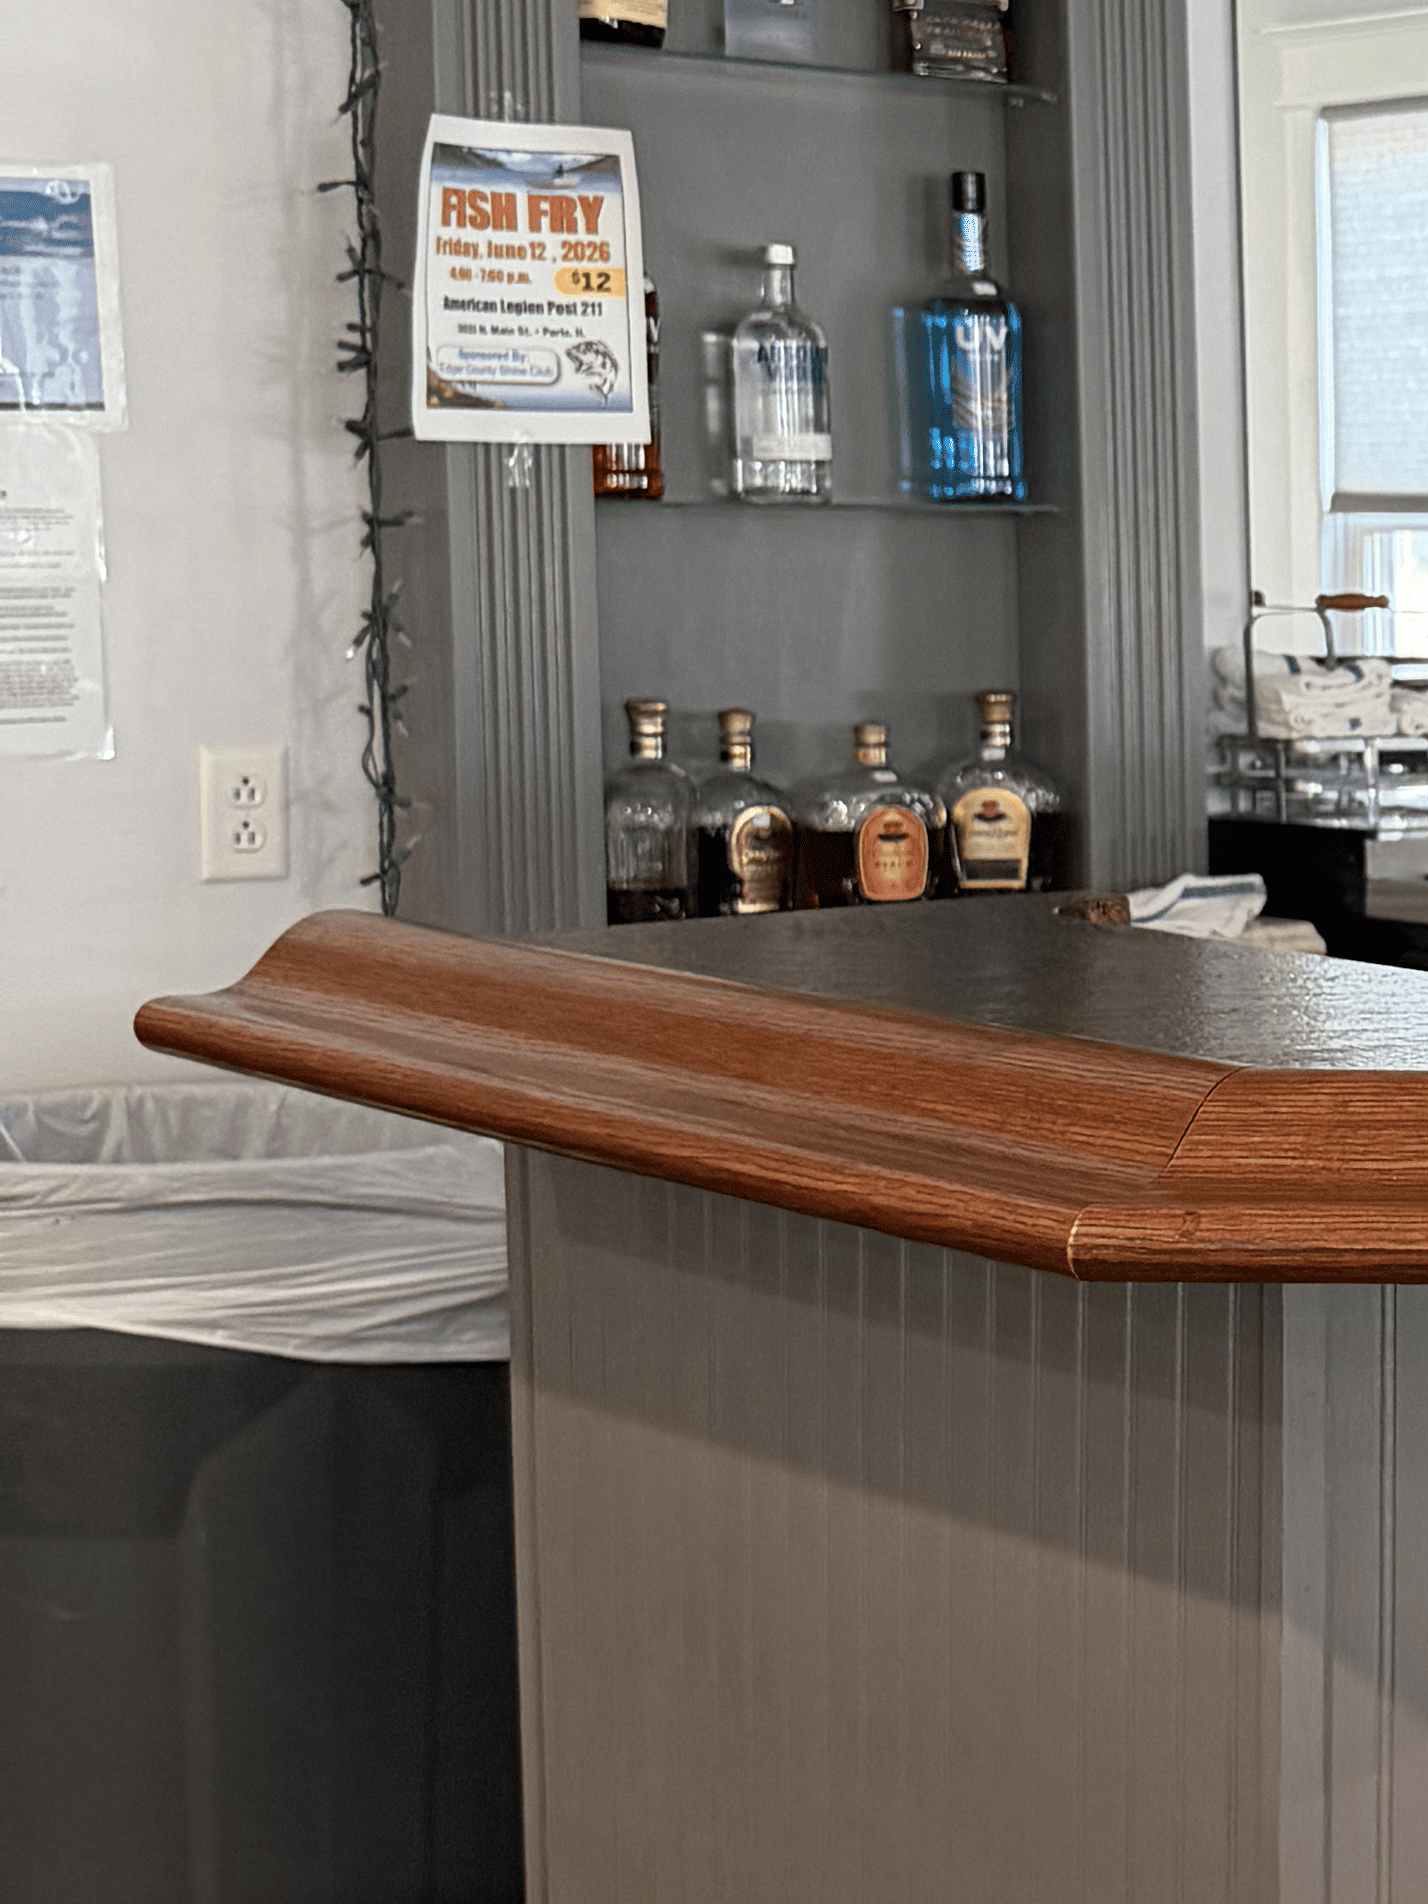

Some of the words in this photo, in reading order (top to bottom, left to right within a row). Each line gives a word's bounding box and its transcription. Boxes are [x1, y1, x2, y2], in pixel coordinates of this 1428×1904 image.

[441, 186, 518, 232] FISH
[527, 194, 605, 235] FRY
[435, 236, 484, 260] Friday,
[487, 239, 528, 259] June
[529, 242, 546, 261] 12
[561, 241, 611, 262] 2026
[571, 269, 612, 293] $12
[443, 295, 497, 313] American
[500, 299, 544, 316] Legion
[547, 300, 578, 315] Post
[580, 302, 603, 317] 211
[955, 325, 1008, 351] UV
